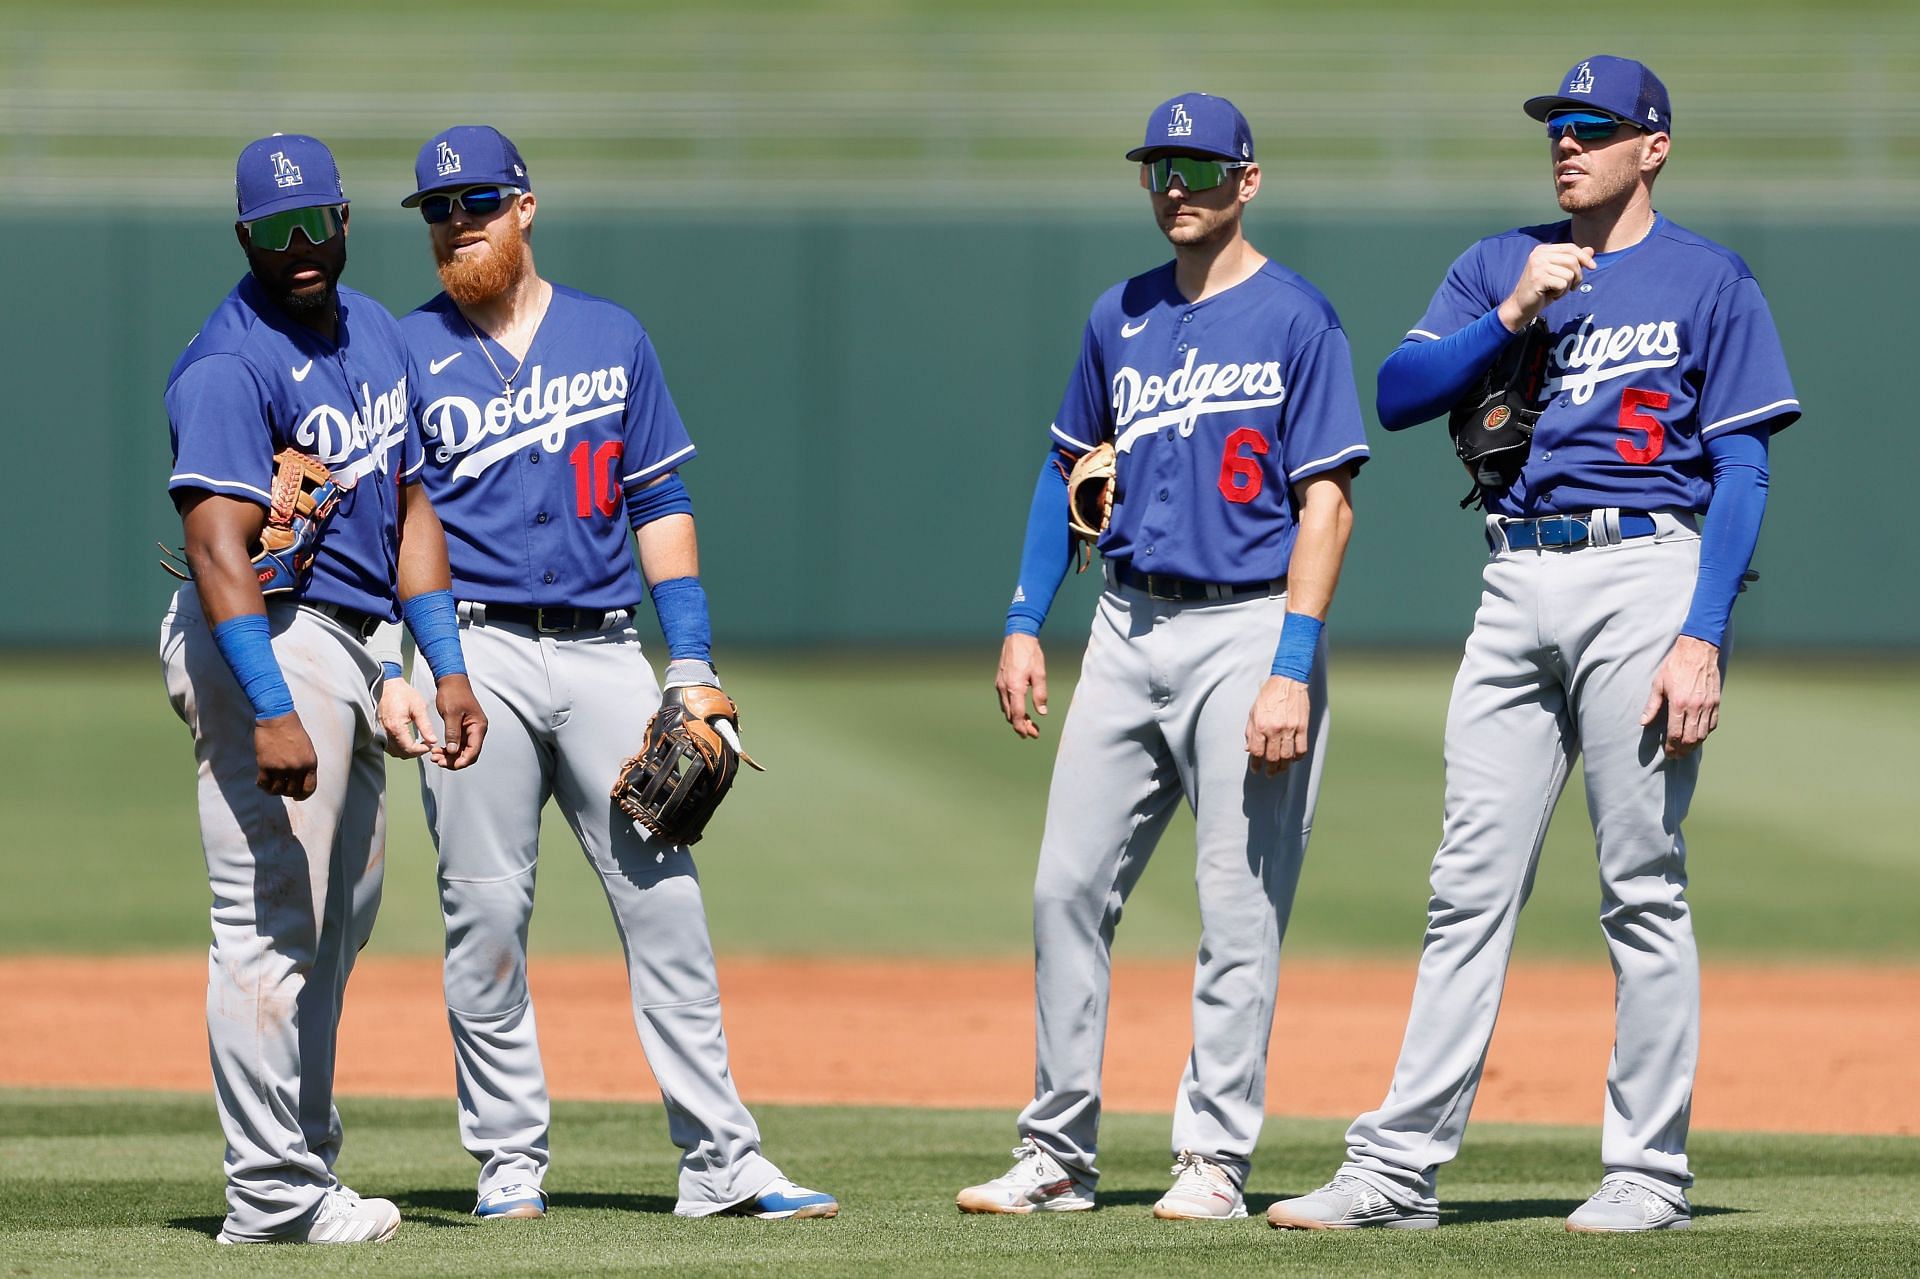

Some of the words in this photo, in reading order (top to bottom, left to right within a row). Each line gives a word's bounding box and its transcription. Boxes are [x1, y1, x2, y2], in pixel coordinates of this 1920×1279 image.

[1569, 61, 1595, 94] LA
[1167, 102, 1193, 136] LA
[270, 151, 304, 188] LA
[436, 141, 462, 177] LA
[1112, 348, 1286, 438] Dodgers
[1549, 314, 1681, 405] dgers
[422, 365, 628, 464] Dodgers
[1616, 386, 1671, 465] 5
[569, 440, 625, 518] 10
[1217, 426, 1270, 504] 6
